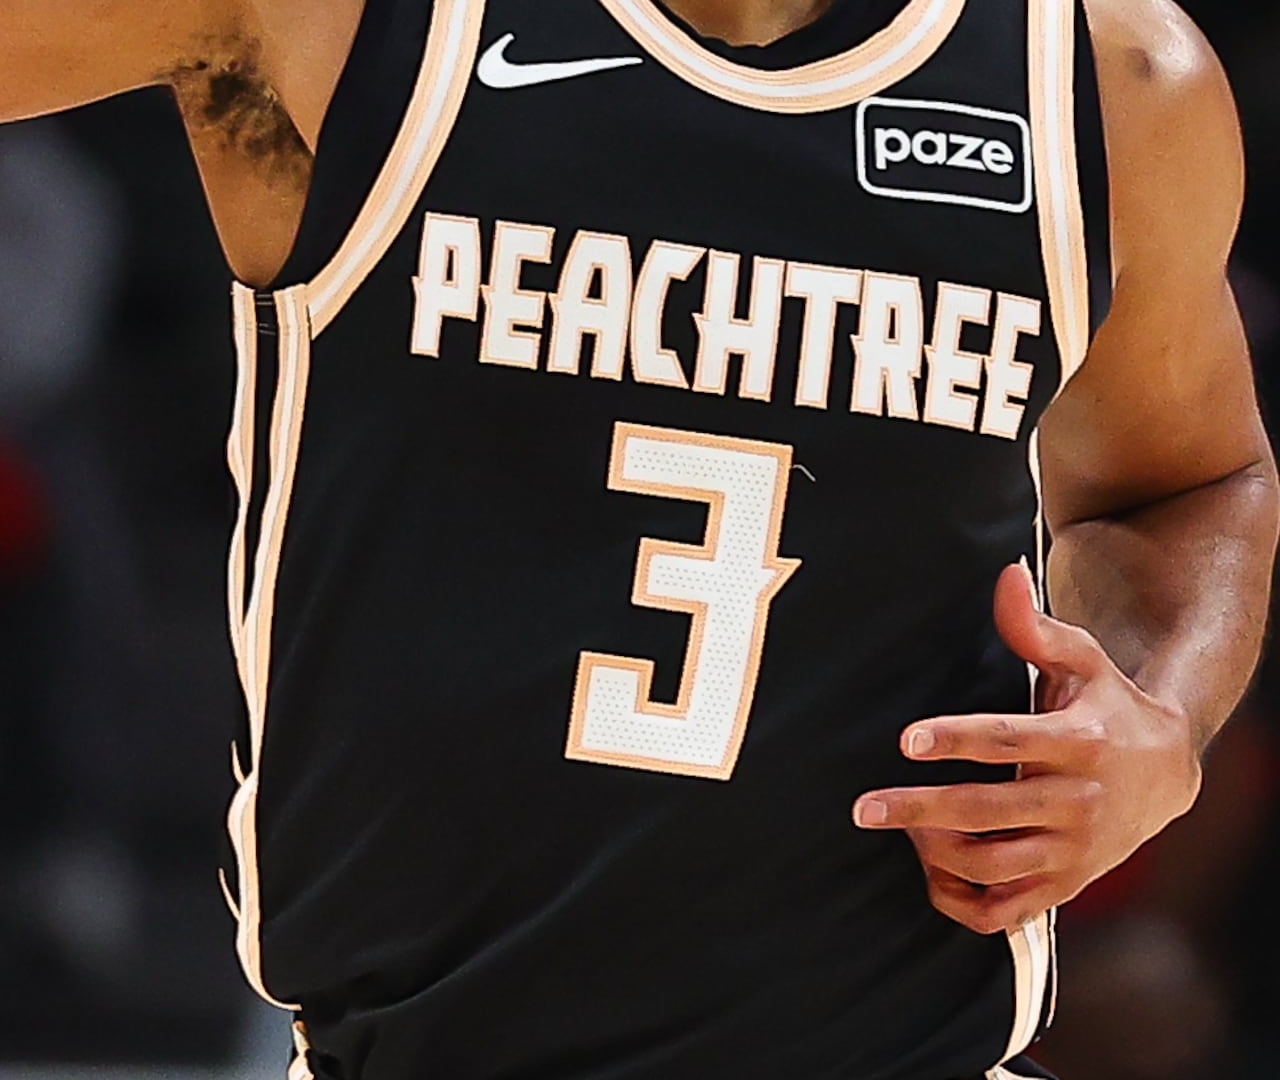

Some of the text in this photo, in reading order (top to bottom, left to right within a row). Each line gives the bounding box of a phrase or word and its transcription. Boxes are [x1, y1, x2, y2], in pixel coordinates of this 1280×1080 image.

[873, 125, 1015, 176] paze
[409, 210, 1042, 441] PEACHTREE
[564, 420, 803, 781] 3
